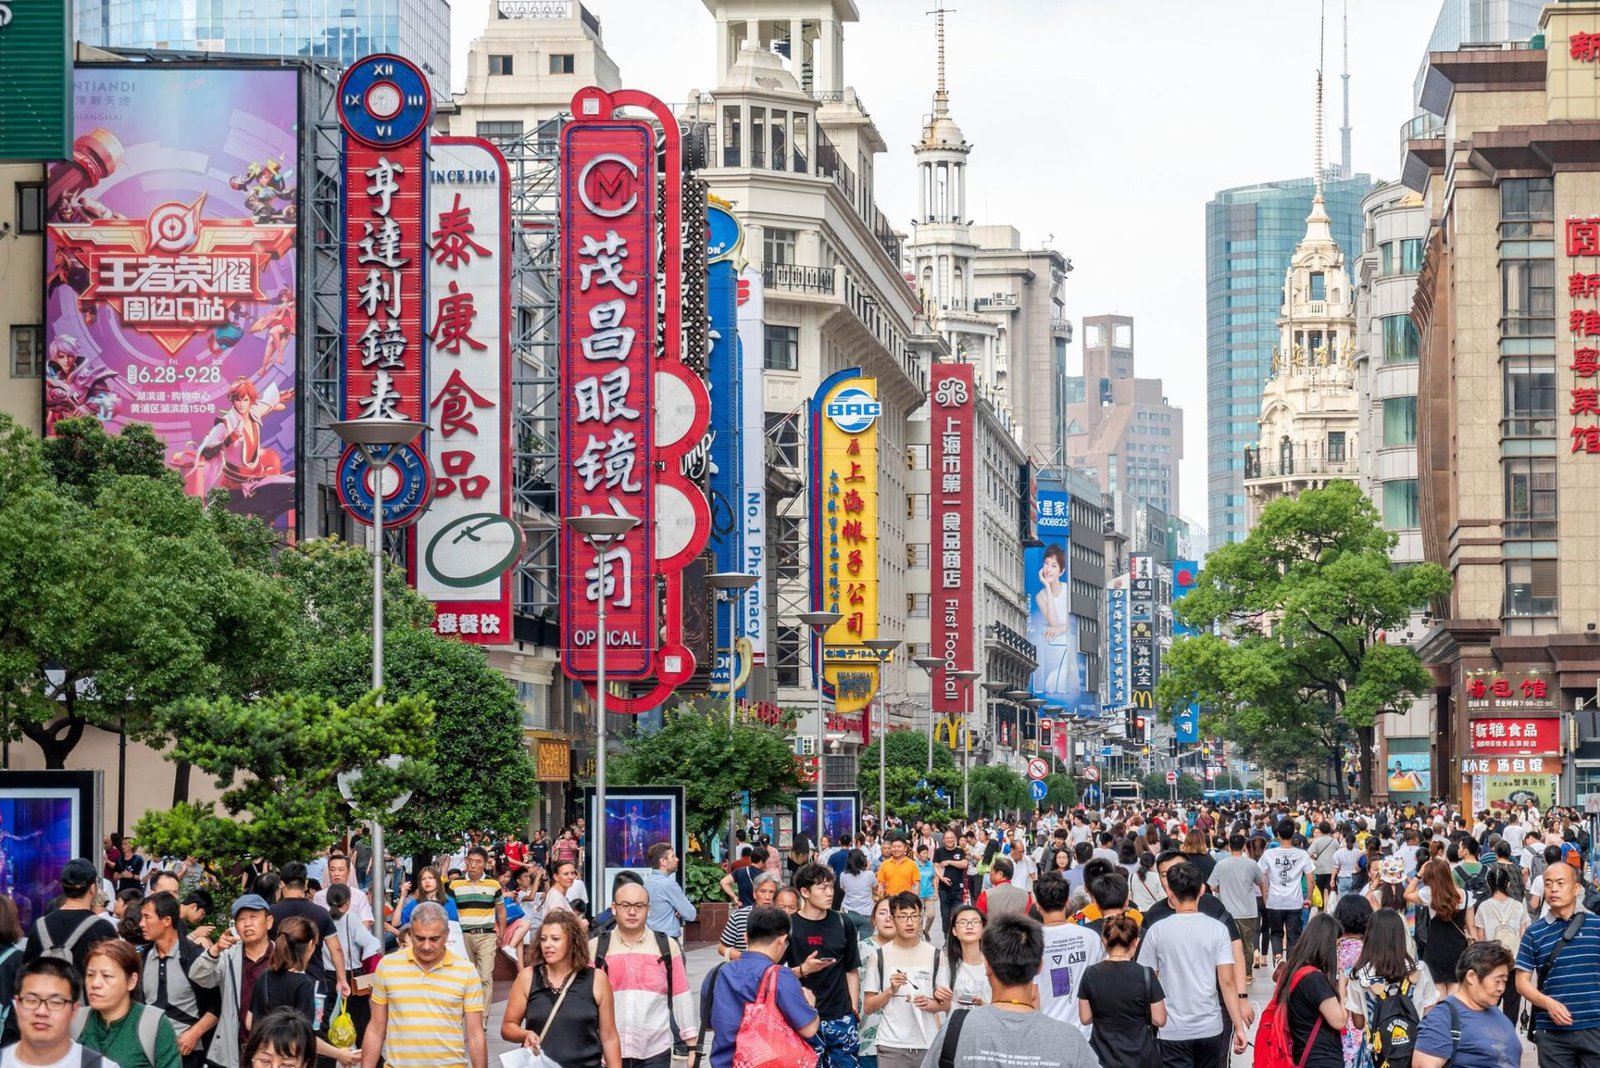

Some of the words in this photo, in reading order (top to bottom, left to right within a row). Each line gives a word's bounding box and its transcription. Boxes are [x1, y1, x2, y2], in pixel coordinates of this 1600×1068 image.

[374, 64, 393, 76] XII
[345, 94, 361, 105] IX
[408, 95, 423, 106] III
[376, 125, 393, 137] VI
[95, 255, 254, 294] 王者荣耀
[123, 296, 226, 323] 周边Q站
[430, 192, 497, 500] 泰康食品
[138, 366, 221, 384] 6.28-9.28
[130, 404, 216, 414] 黄浦区湖滨路150号
[827, 403, 880, 416] BAC
[942, 417, 961, 589] 上海市第一食品商店
[1037, 501, 1069, 517] 星家
[747, 492, 761, 535] No.1
[945, 599, 960, 628] First
[573, 630, 641, 646] OPICAL
[1476, 723, 1538, 738] 新雅食品
